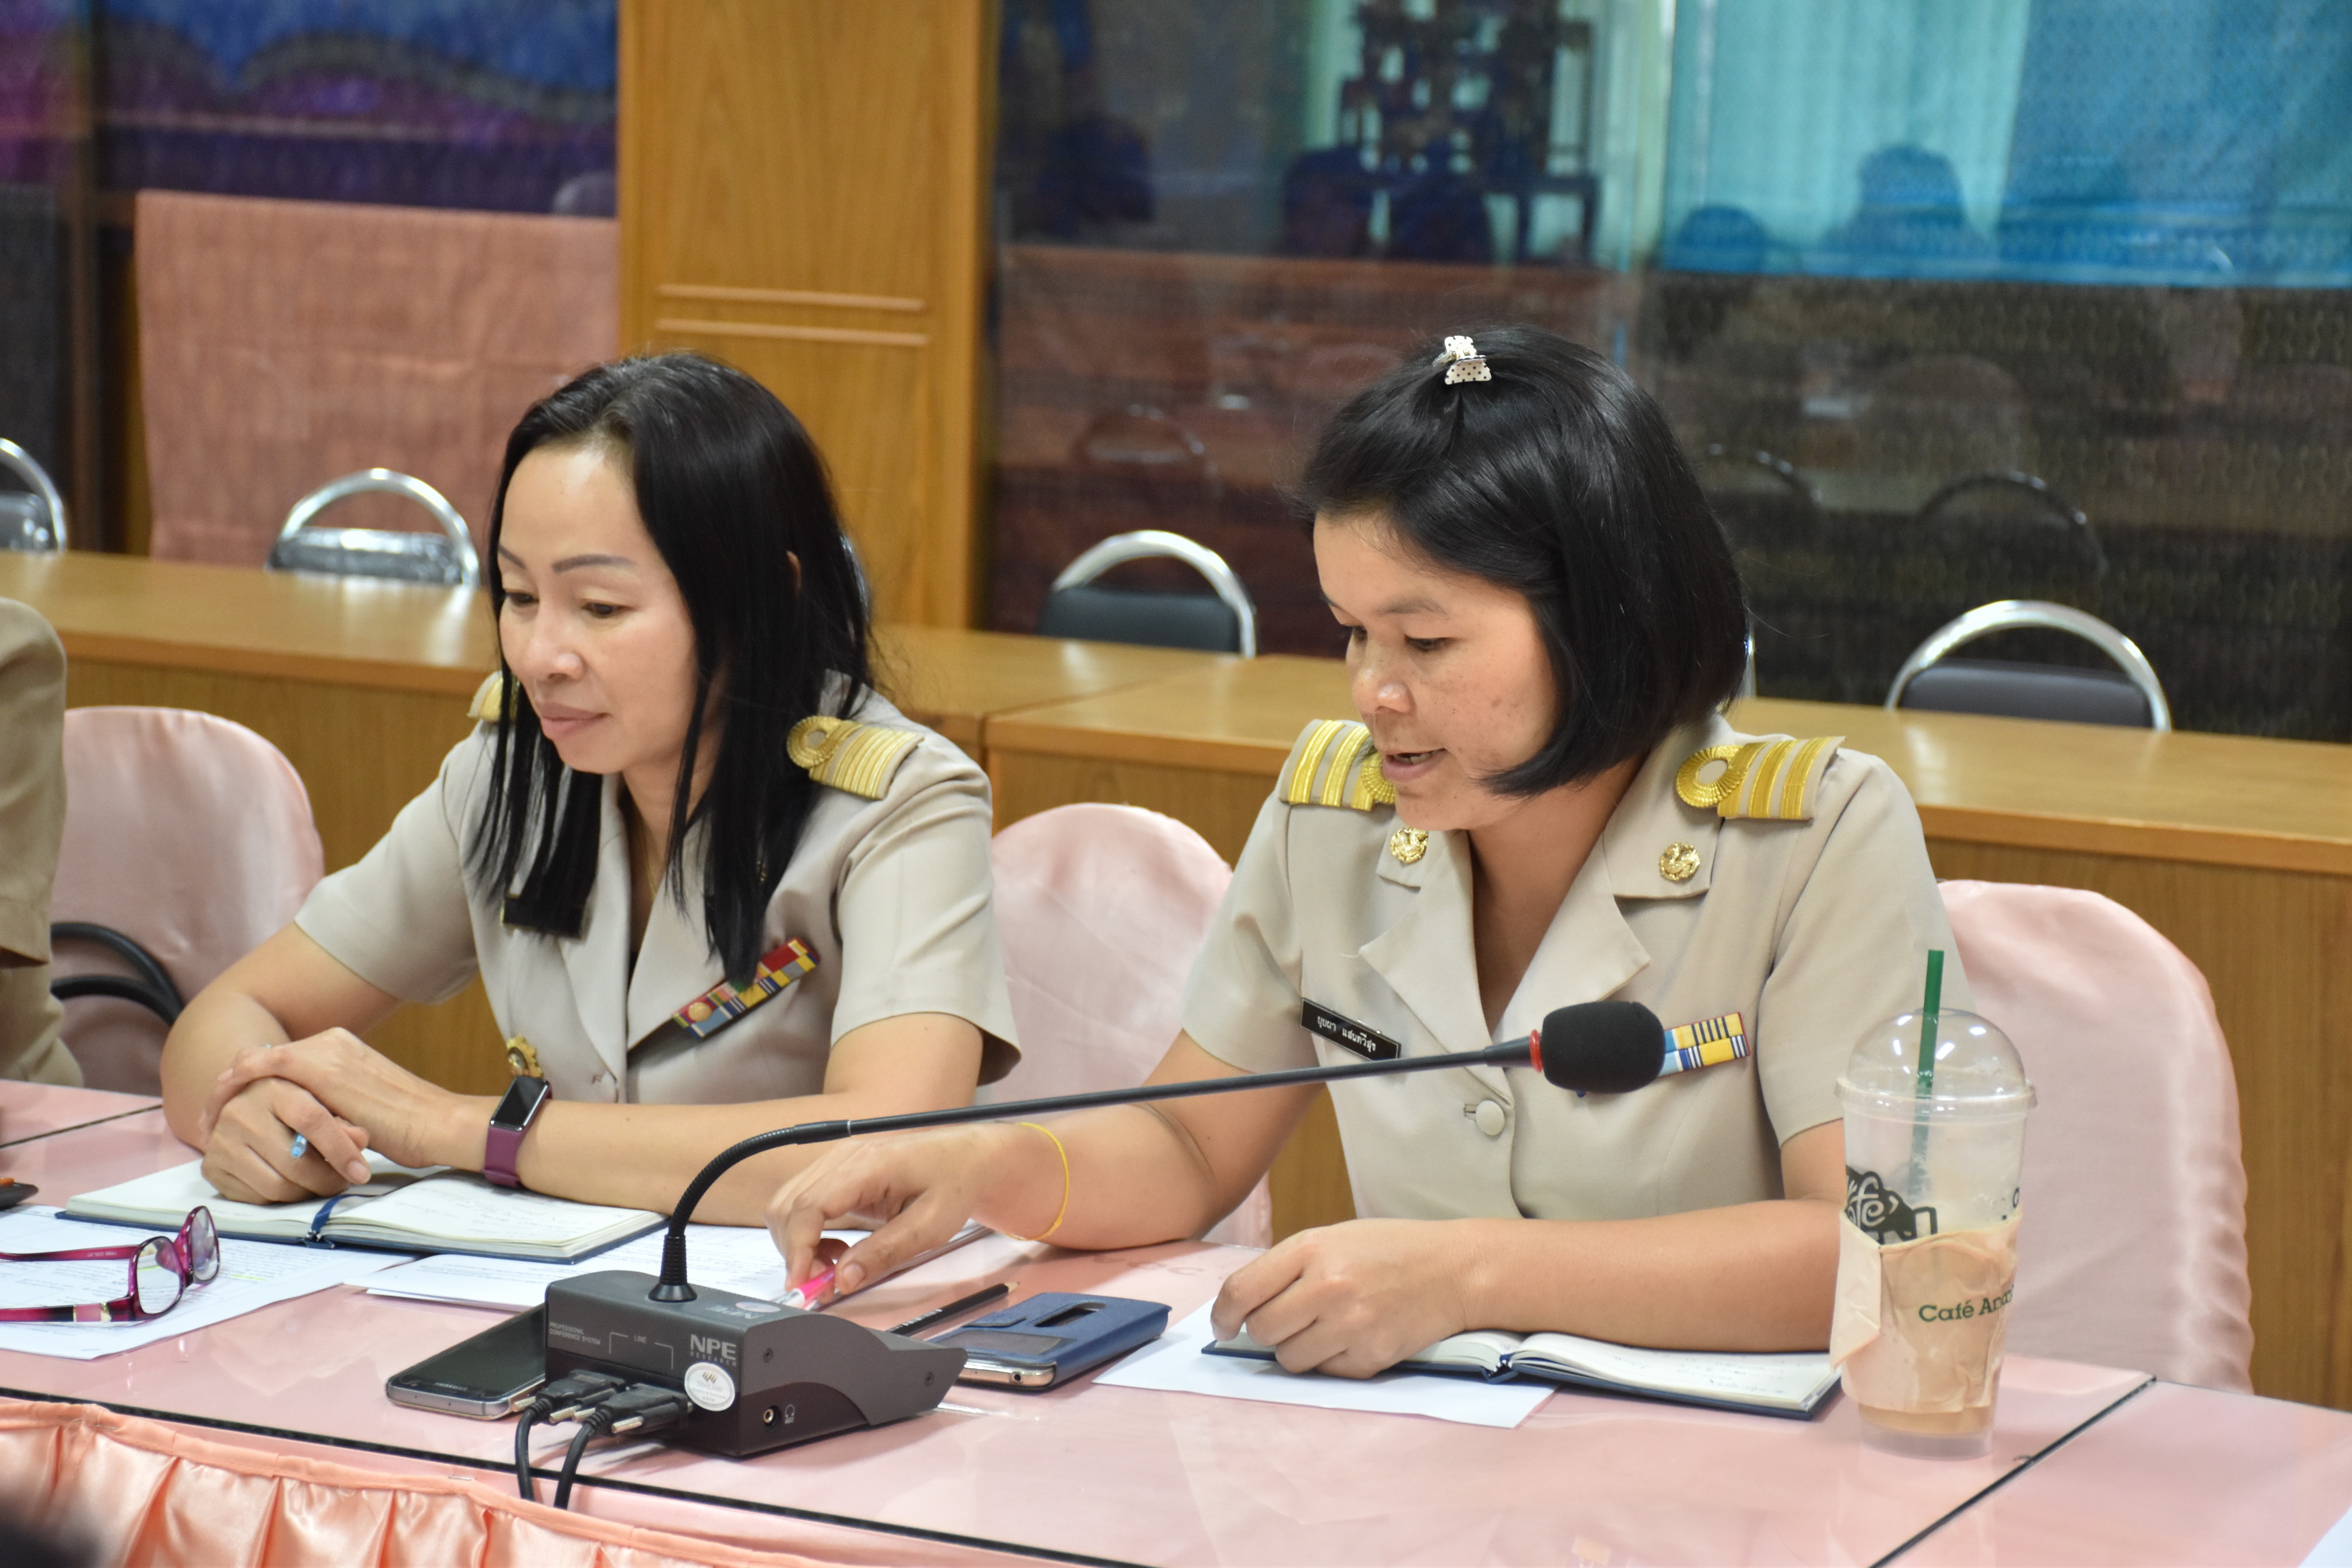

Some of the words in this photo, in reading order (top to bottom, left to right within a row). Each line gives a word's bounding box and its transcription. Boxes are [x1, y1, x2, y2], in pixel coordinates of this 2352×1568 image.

[1919, 1299, 1975, 1322] Café
[549, 1328, 581, 1341] CONFERENCE
[582, 1335, 601, 1345] SYSTEM
[634, 1334, 647, 1344] LINE
[689, 1333, 737, 1361] NPE
[689, 1351, 737, 1367] RESEARCH
